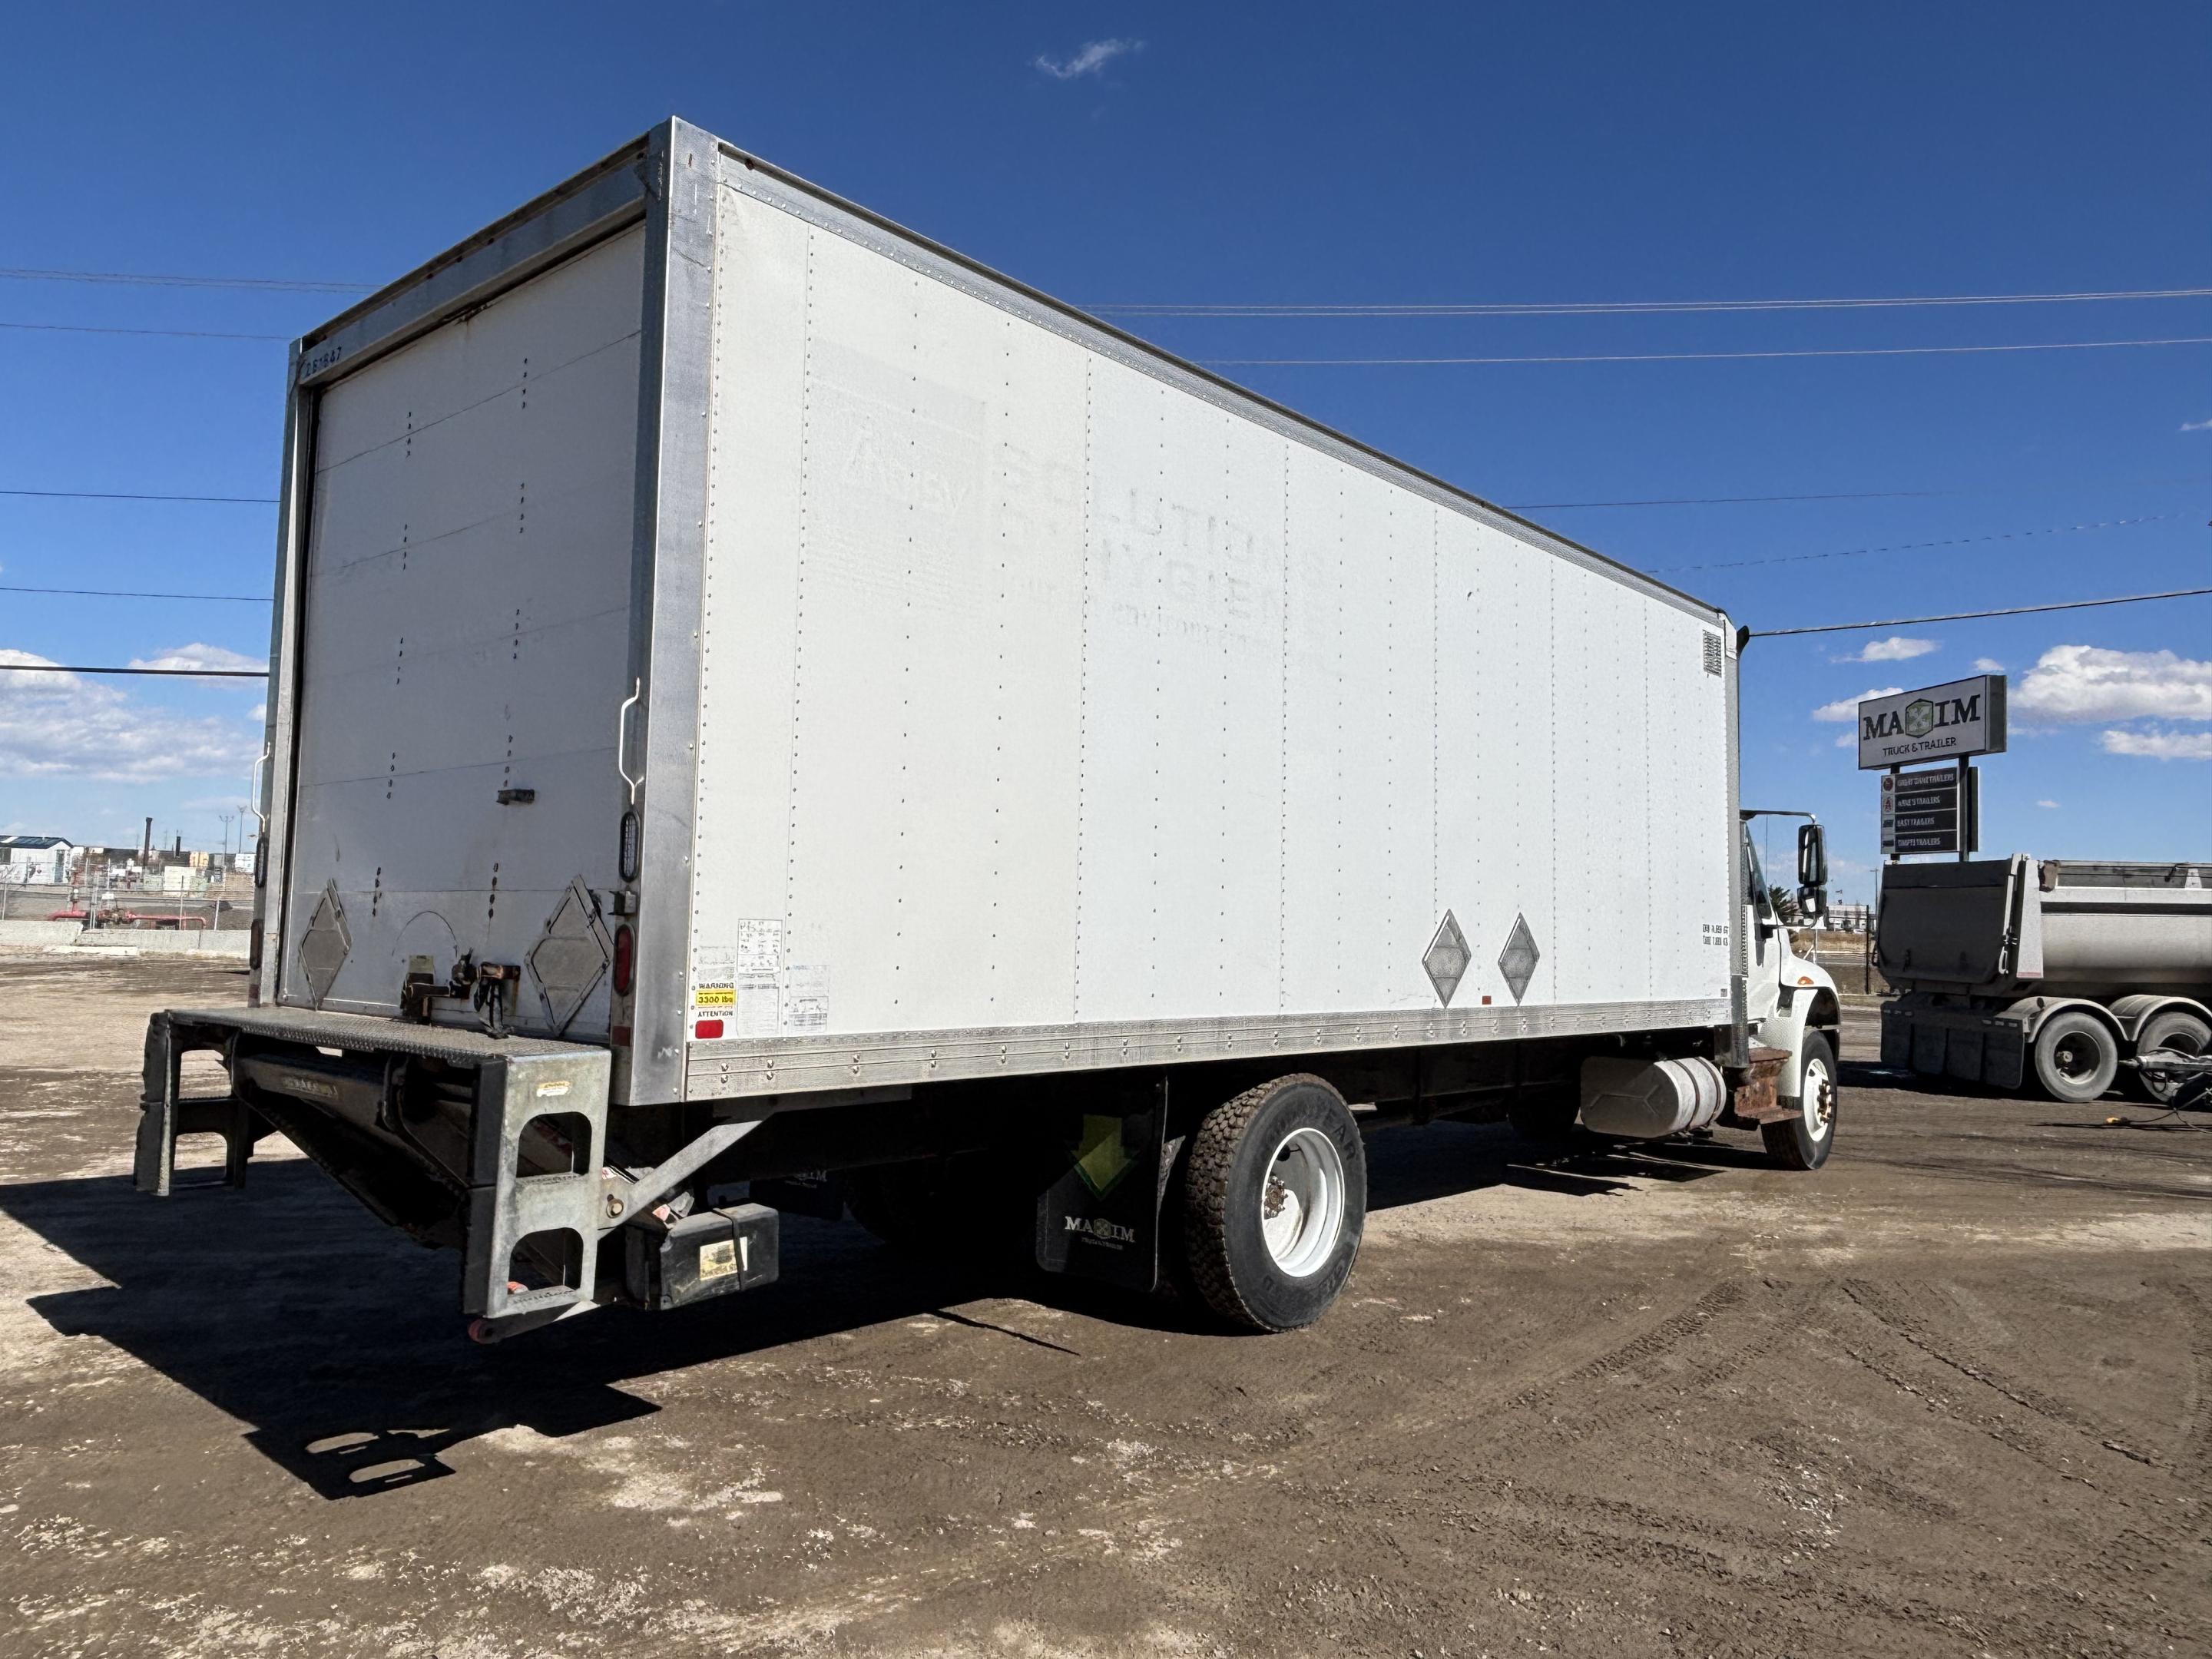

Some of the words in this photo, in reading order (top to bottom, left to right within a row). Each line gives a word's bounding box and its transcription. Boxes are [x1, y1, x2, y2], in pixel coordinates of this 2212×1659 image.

[1863, 694, 1982, 741] MAXIM
[1883, 743, 1910, 757] TRUCK
[1912, 741, 1919, 752] &
[1919, 737, 1957, 750] TRAILER
[1065, 1216, 1137, 1243] MAXIM
